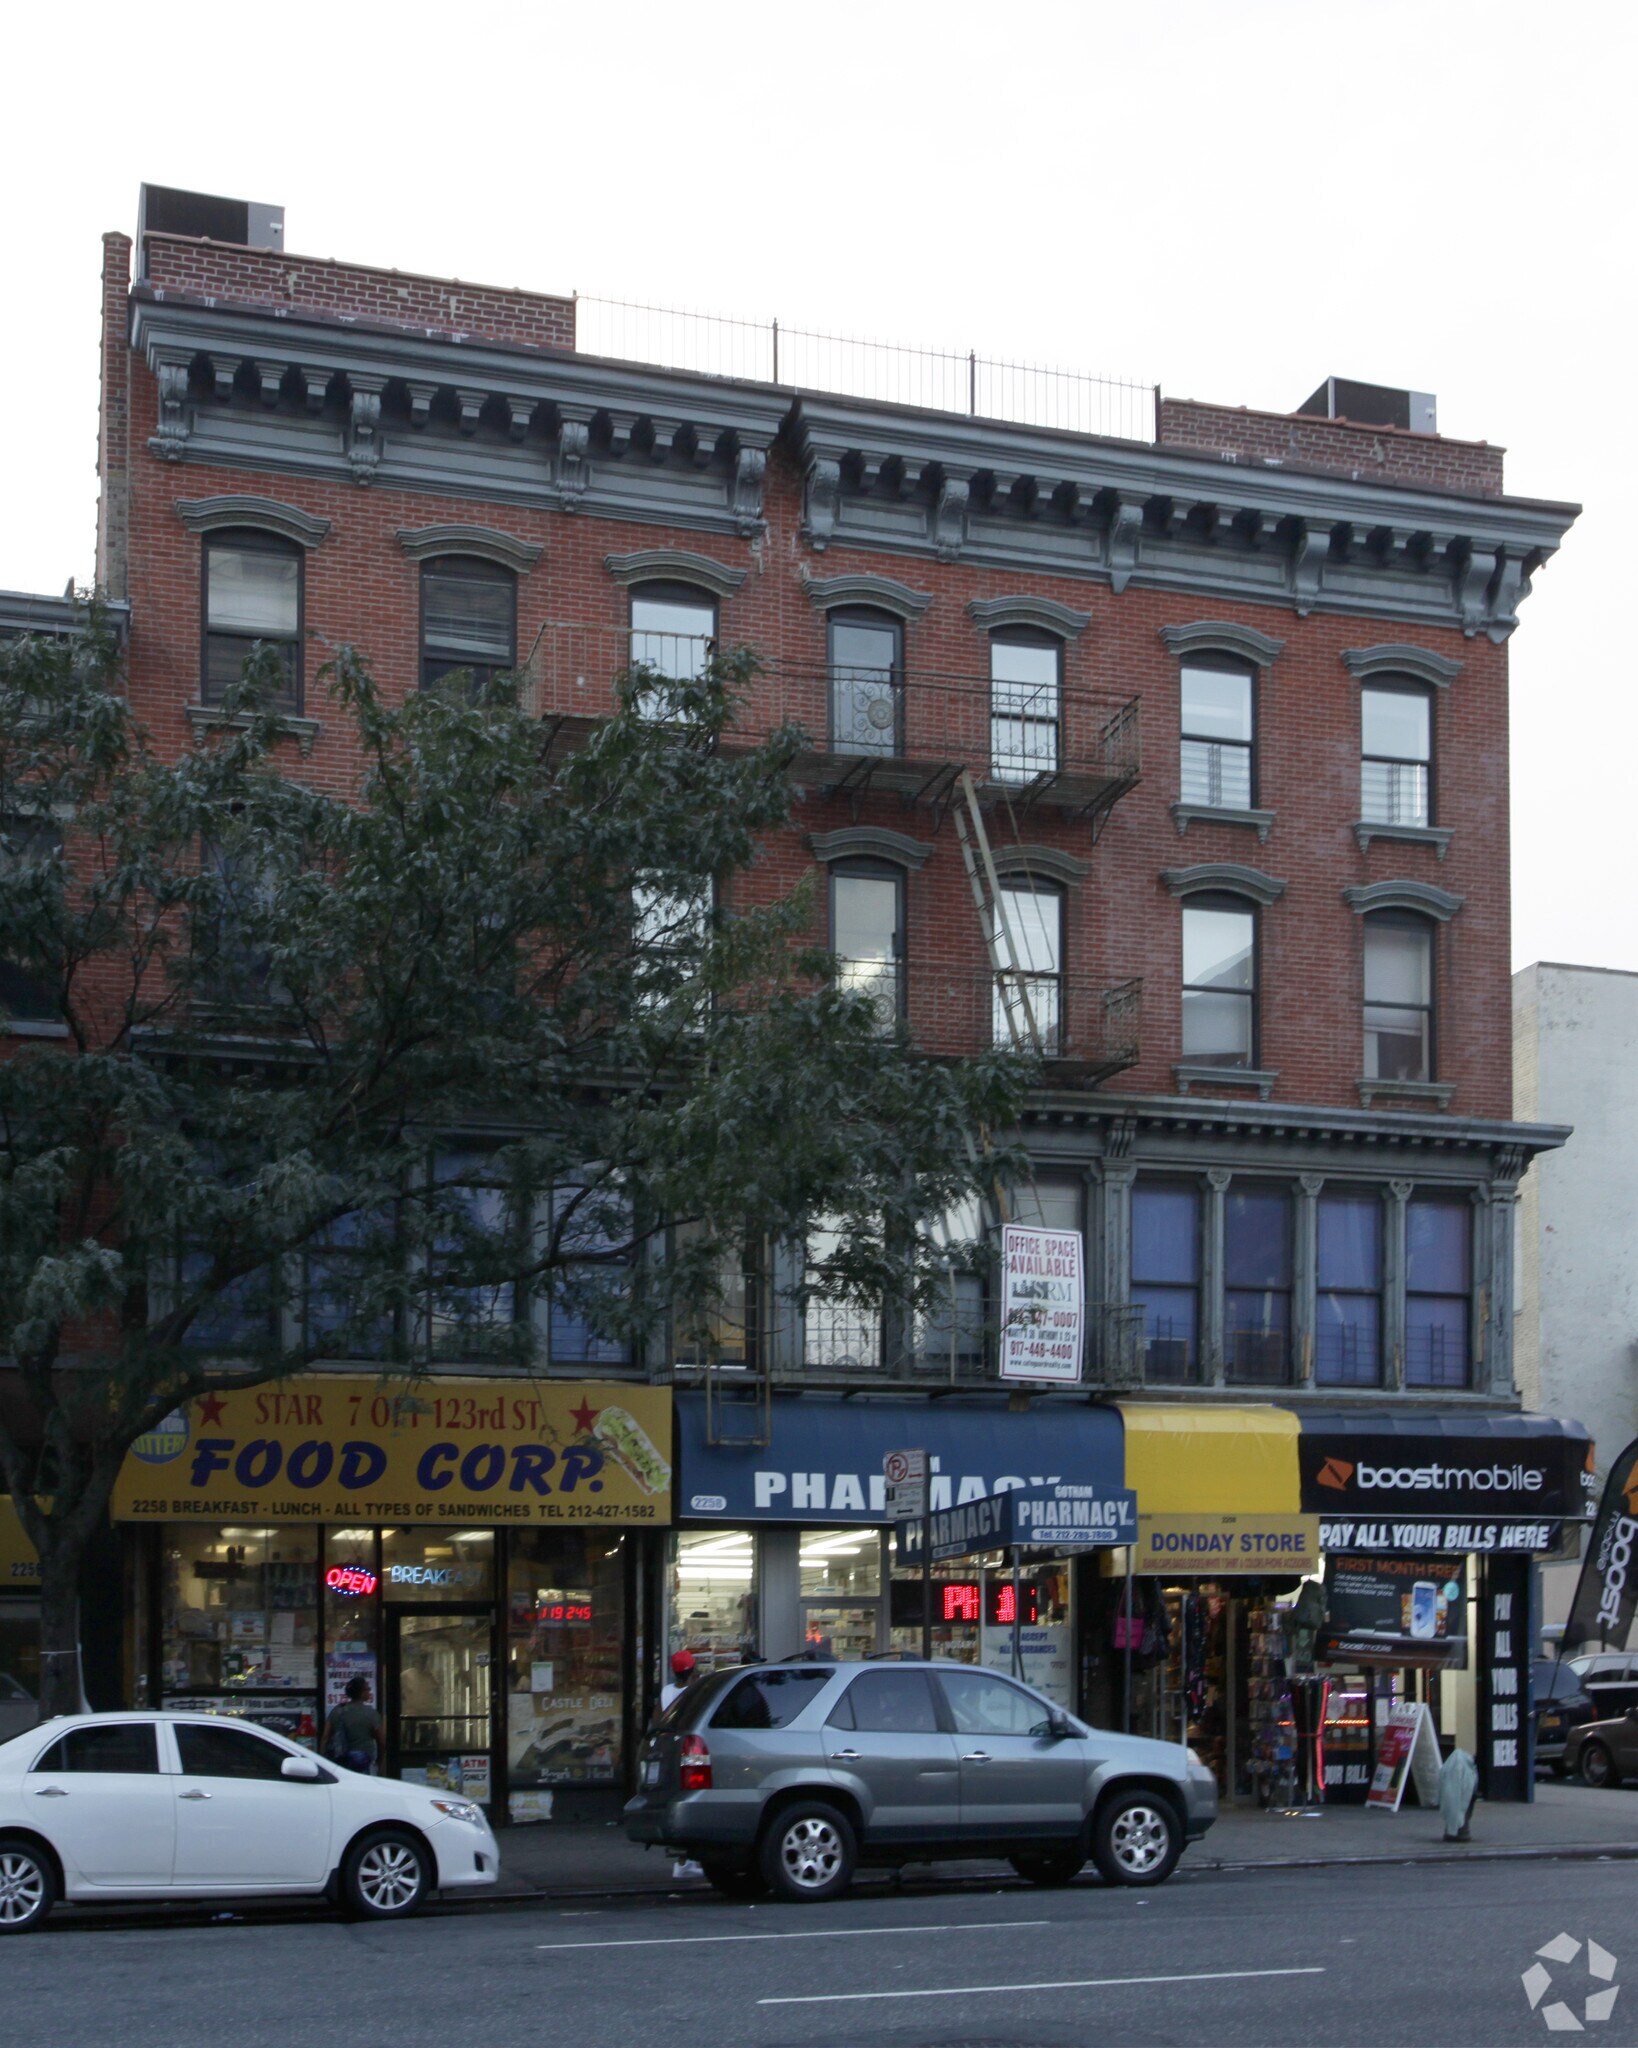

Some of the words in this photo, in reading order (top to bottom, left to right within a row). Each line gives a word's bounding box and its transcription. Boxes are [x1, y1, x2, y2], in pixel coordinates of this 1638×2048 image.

[1008, 1235, 1041, 1254] OFFICE
[1045, 1239, 1076, 1258] SPACE
[1009, 1254, 1076, 1277] AVAILABLE
[254, 1392, 323, 1426] STAR
[433, 1396, 506, 1430] 123rd
[191, 1439, 387, 1490] FOOD
[1054, 1485, 1094, 1499] GOTHAM
[133, 1500, 167, 1513] 2258
[172, 1501, 258, 1515] BREAKFAST
[272, 1503, 321, 1515] LUNCH
[334, 1504, 361, 1516] ALL
[366, 1504, 411, 1516] TYPES
[415, 1504, 433, 1517] OF
[438, 1504, 531, 1518] SANDWICHES
[539, 1505, 564, 1517] TEL
[1018, 1500, 1129, 1527] PHARMACY
[1151, 1533, 1235, 1552] DONDAY
[1240, 1533, 1306, 1552] STORE
[1319, 1523, 1354, 1547] PAY
[1354, 1523, 1390, 1548] ALL
[1391, 1524, 1441, 1548] YOUR
[1443, 1524, 1498, 1549] BILLS
[1499, 1525, 1551, 1549] HERE
[1335, 1557, 1374, 1573] FIRST
[1376, 1560, 1426, 1577] MONTH
[1427, 1564, 1462, 1580] FREE
[326, 1568, 377, 1595] OPEN
[464, 1759, 487, 1769] ATM
[464, 1772, 487, 1783] ONLY
